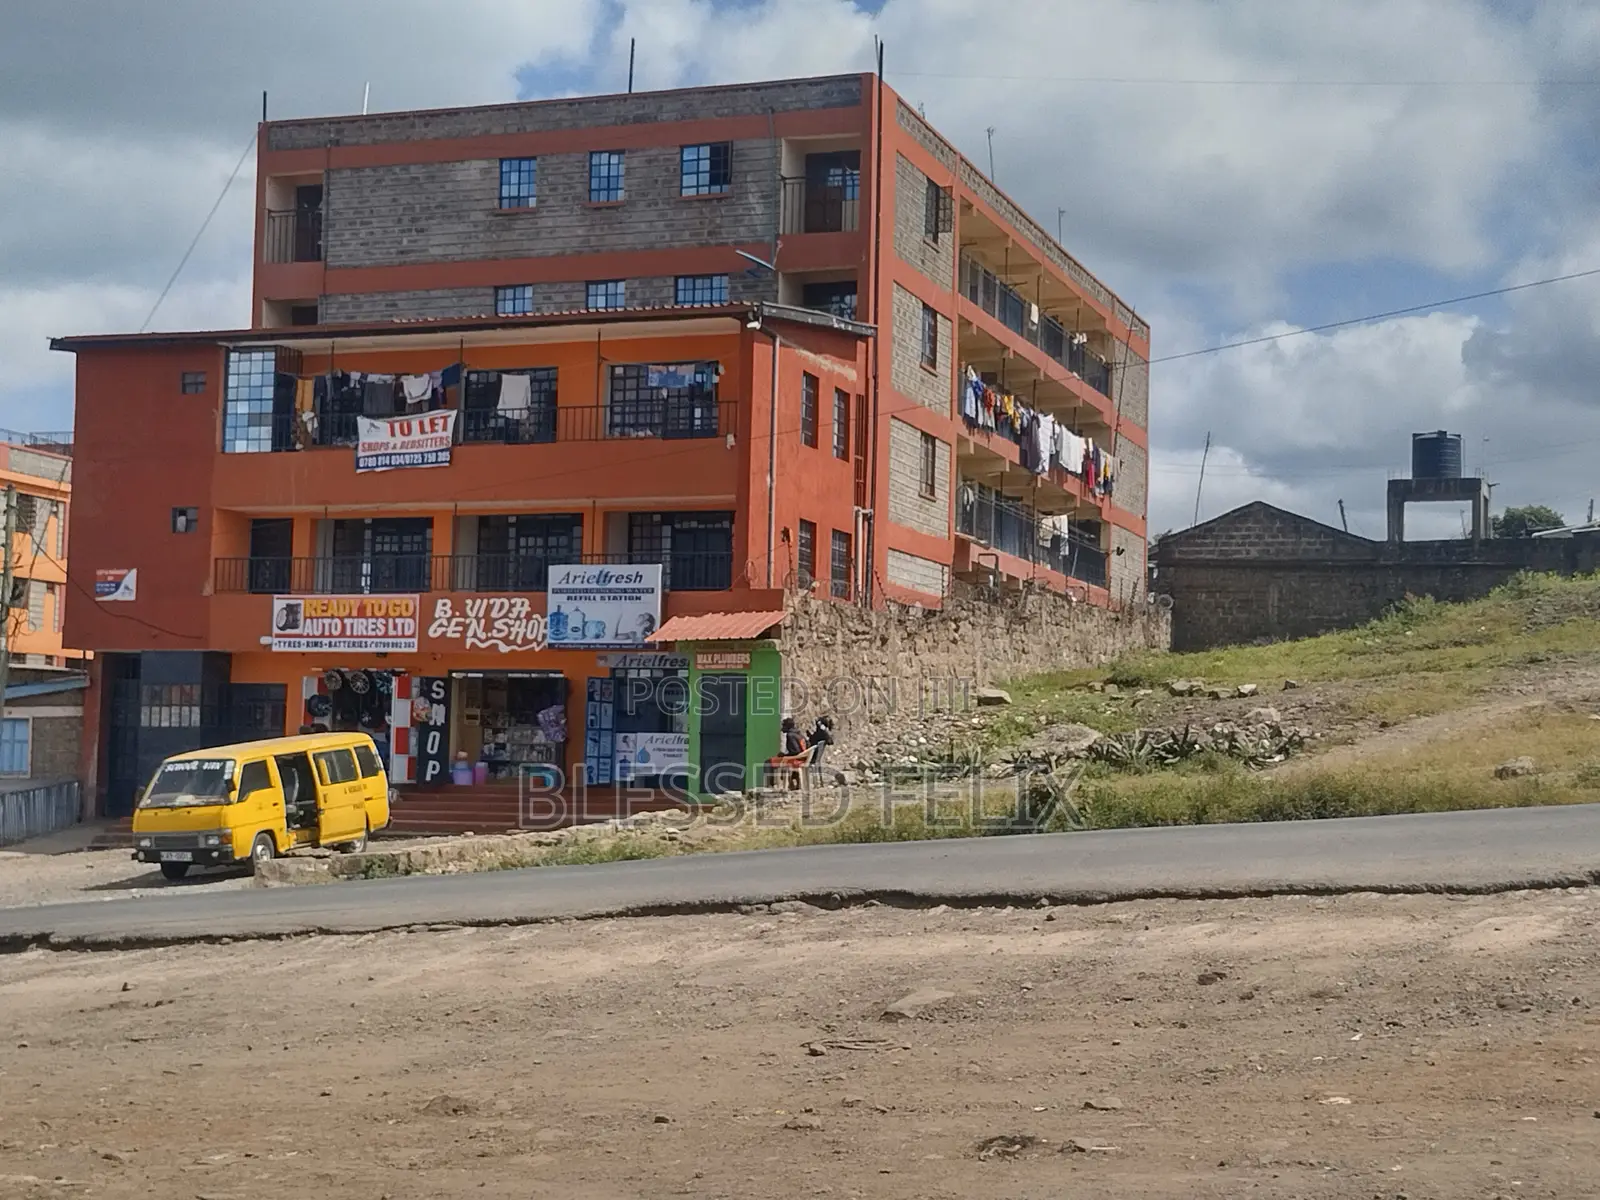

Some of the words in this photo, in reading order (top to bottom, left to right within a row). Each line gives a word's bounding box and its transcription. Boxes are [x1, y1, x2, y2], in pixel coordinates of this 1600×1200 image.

[388, 420, 412, 438] TO
[417, 415, 451, 435] LET
[360, 441, 390, 452] SHOPS
[391, 442, 397, 450] &
[400, 436, 451, 451] BEDSITTERS
[558, 568, 643, 586] Arielfresh
[304, 599, 361, 617] READY
[364, 598, 385, 617] TO
[388, 598, 414, 617] GO
[465, 598, 531, 619] VIDA
[303, 618, 342, 636] AUTO
[344, 618, 386, 636] TIRES
[388, 618, 415, 636] LTD
[277, 640, 301, 648] TYRES
[305, 640, 323, 648] RIMS
[328, 640, 368, 648] BATTERIES
